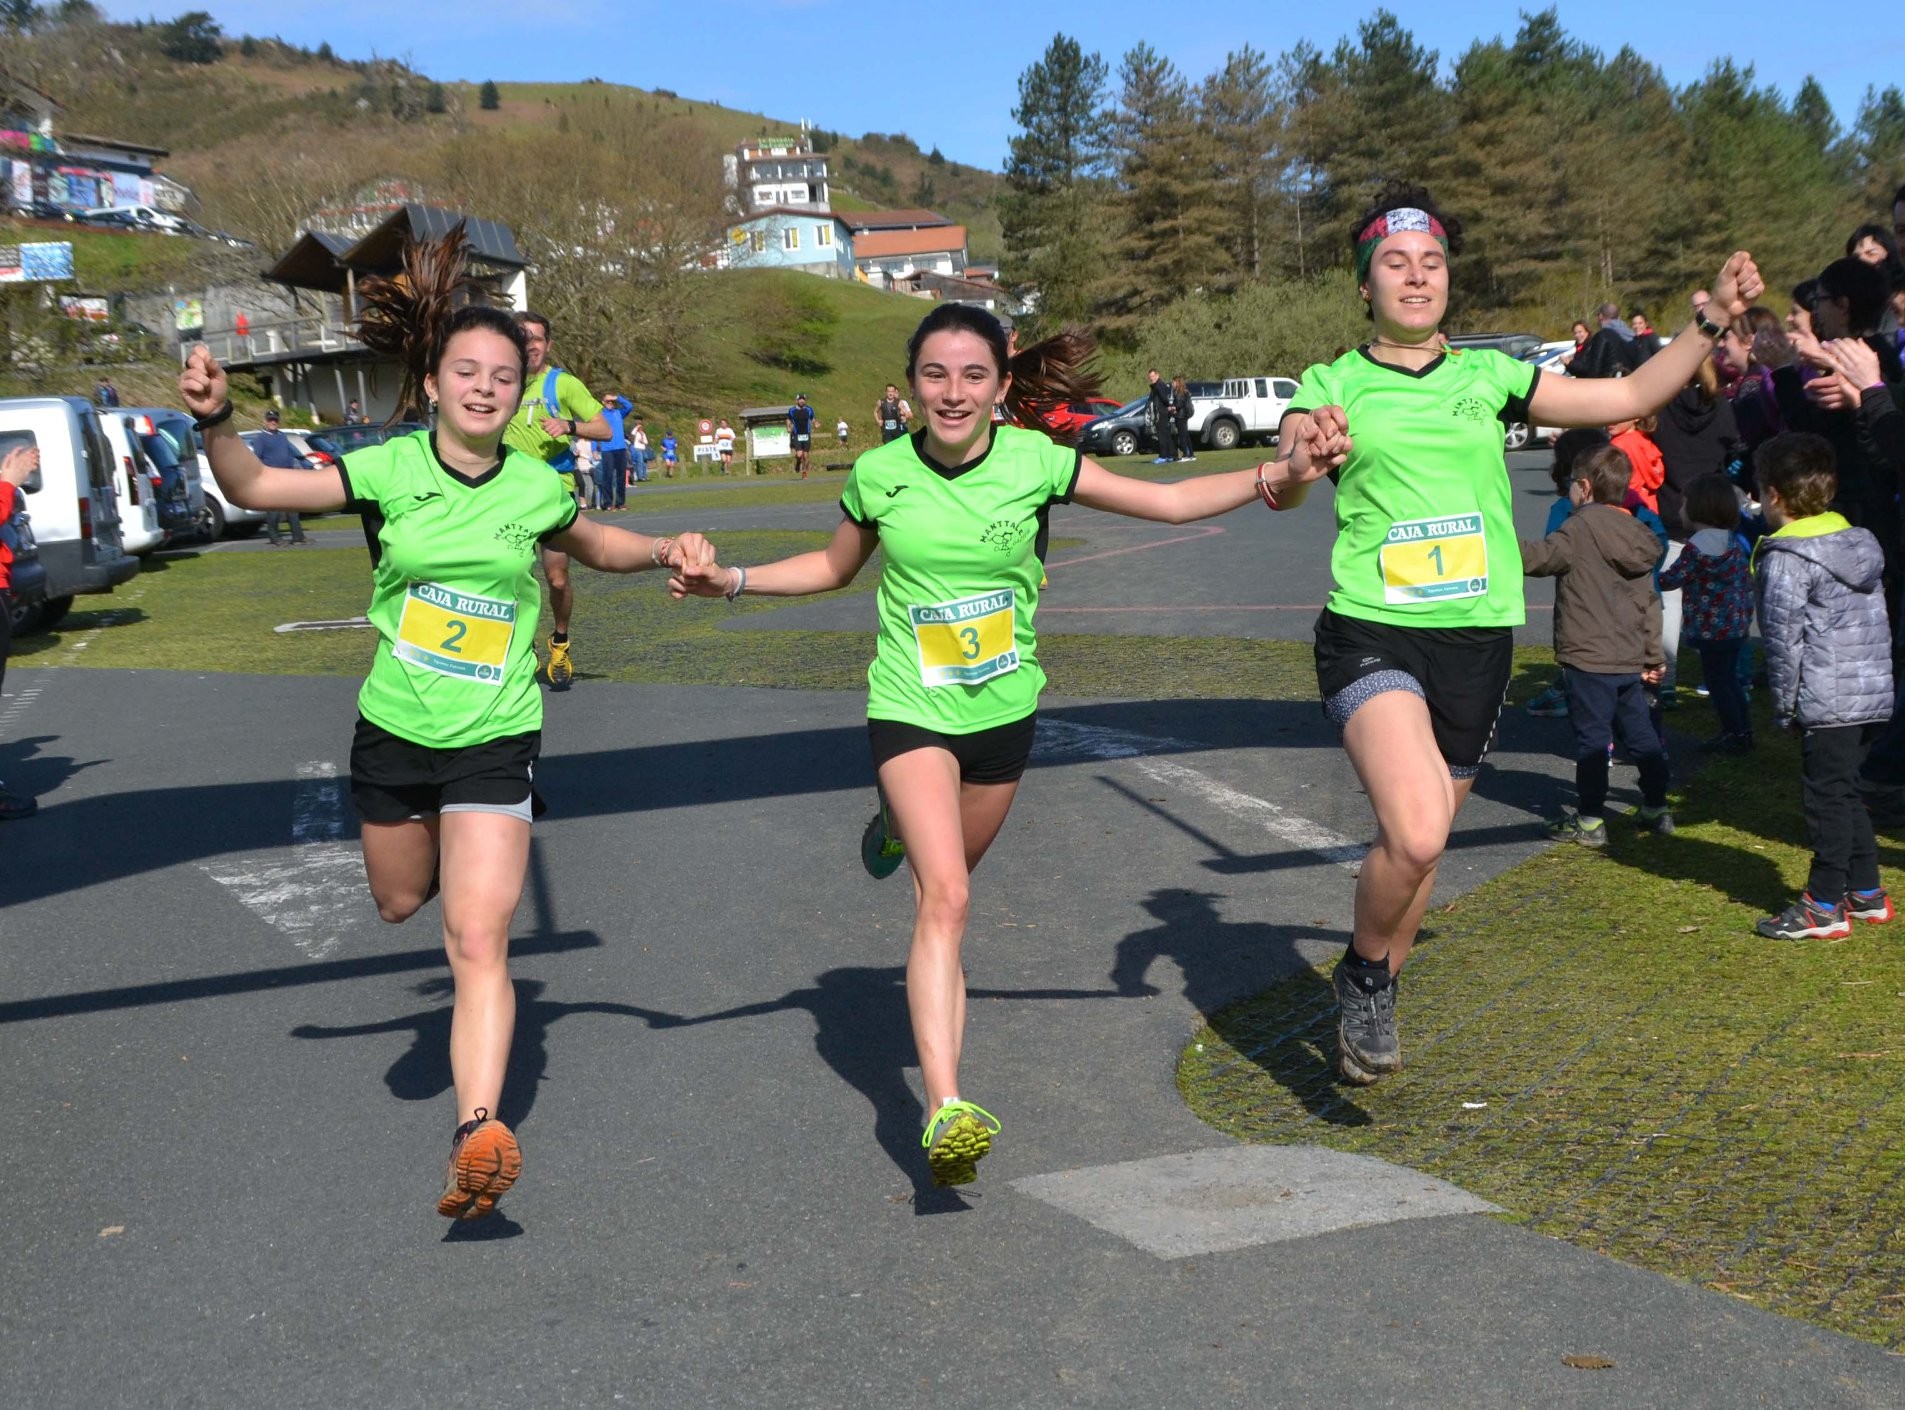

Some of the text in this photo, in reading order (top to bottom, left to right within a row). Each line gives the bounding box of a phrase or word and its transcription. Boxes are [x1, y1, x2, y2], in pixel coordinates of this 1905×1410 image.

[1387, 519, 1477, 541] CAJA RURAL
[1428, 545, 1444, 576] 1
[417, 585, 510, 619] CAJA RURAL
[919, 595, 1008, 621] CAJA RURAL
[440, 620, 467, 653] 2
[960, 627, 981, 660] 3
